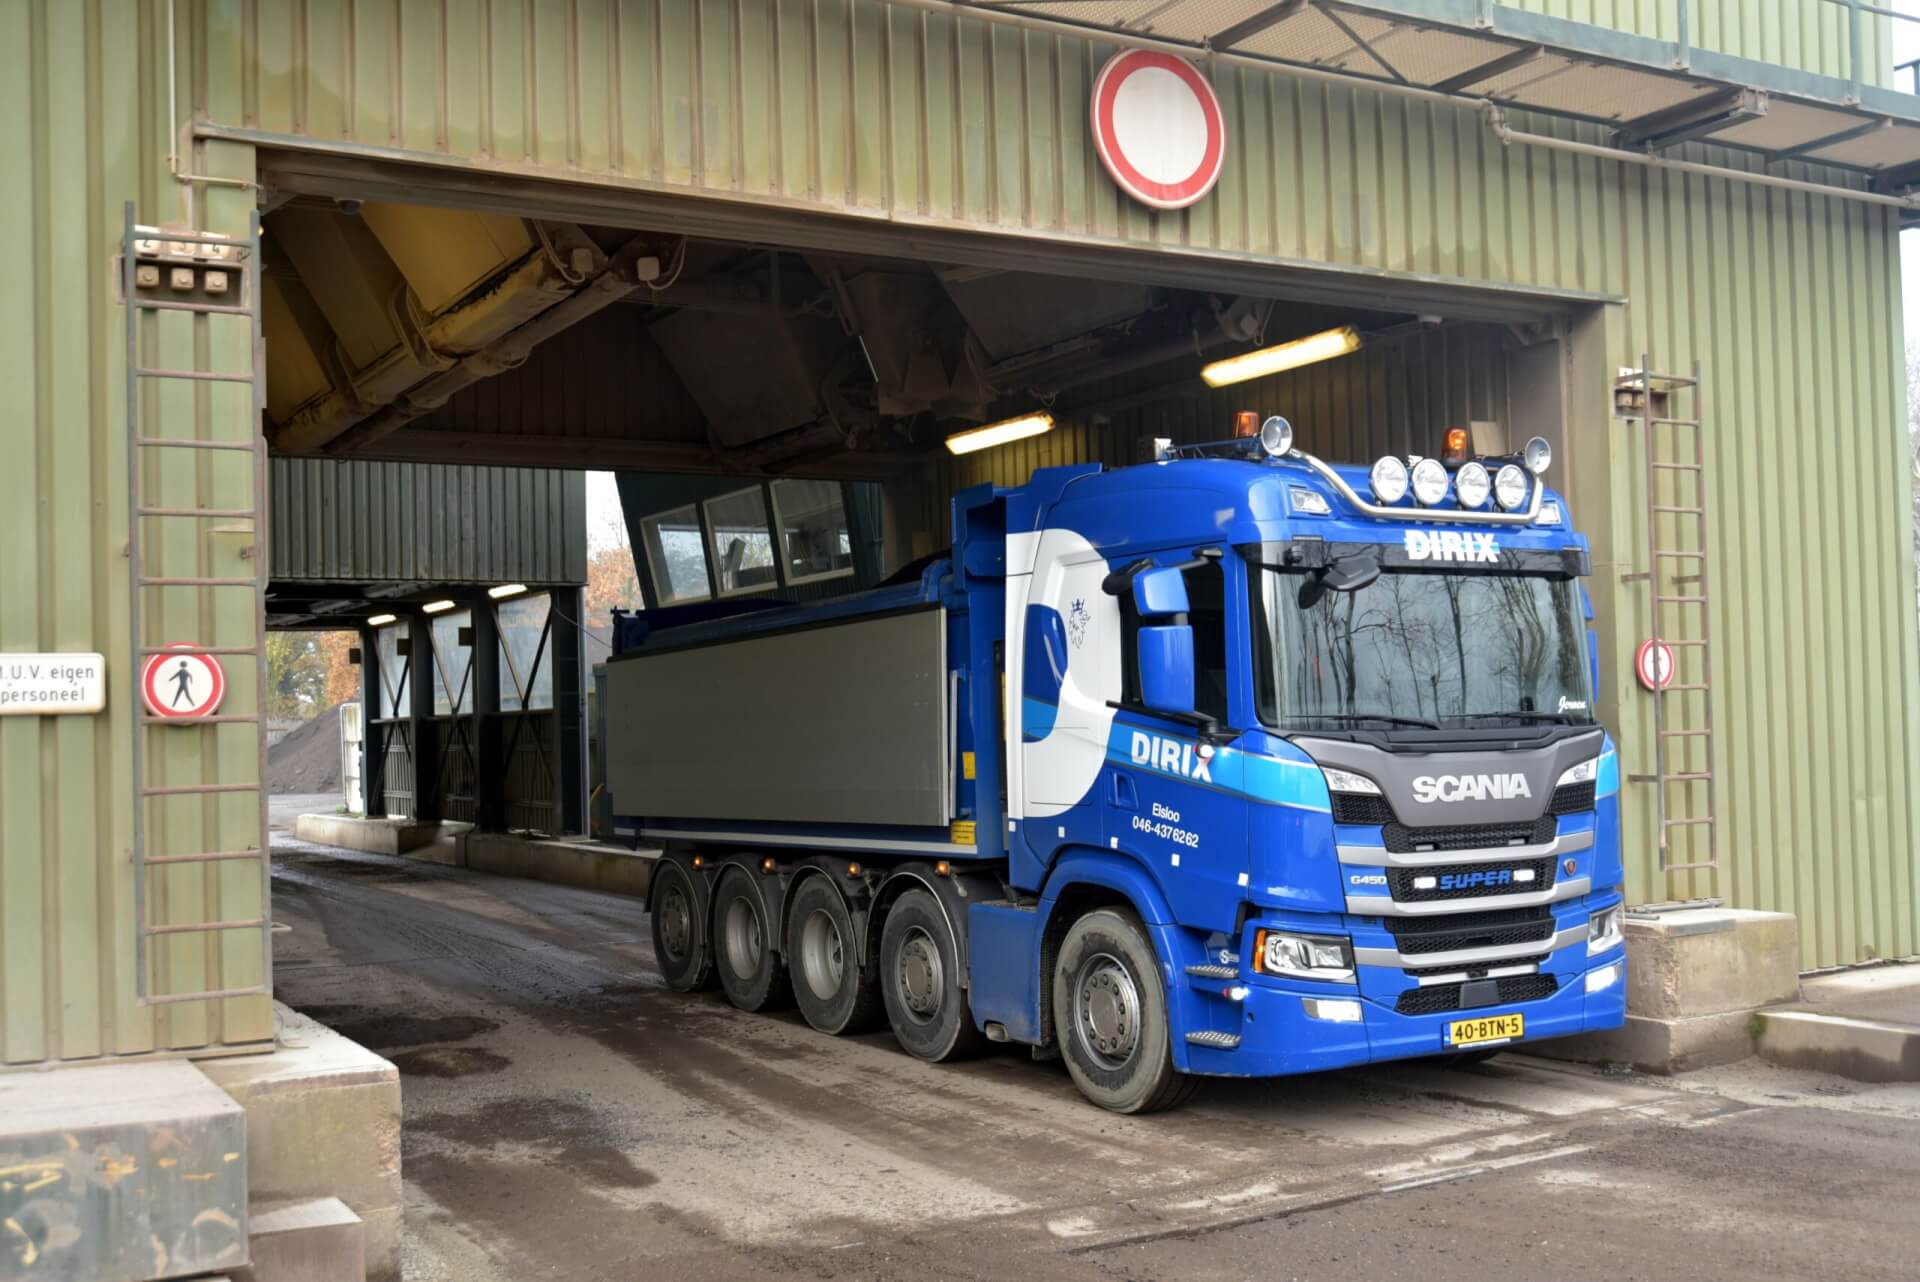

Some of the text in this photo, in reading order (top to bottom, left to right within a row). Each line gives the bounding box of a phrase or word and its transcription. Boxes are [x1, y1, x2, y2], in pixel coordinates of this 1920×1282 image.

[1404, 529, 1499, 562] DIRIX
[50, 664, 94, 683] eigen
[1, 687, 84, 704] personeel
[1131, 731, 1213, 784] DIRIX
[1412, 773, 1532, 803] SCANIA
[1132, 815, 1199, 849] 046-4376262
[1350, 870, 1512, 890] G450 SUPER
[1455, 1017, 1519, 1041] 40-BTN-5
